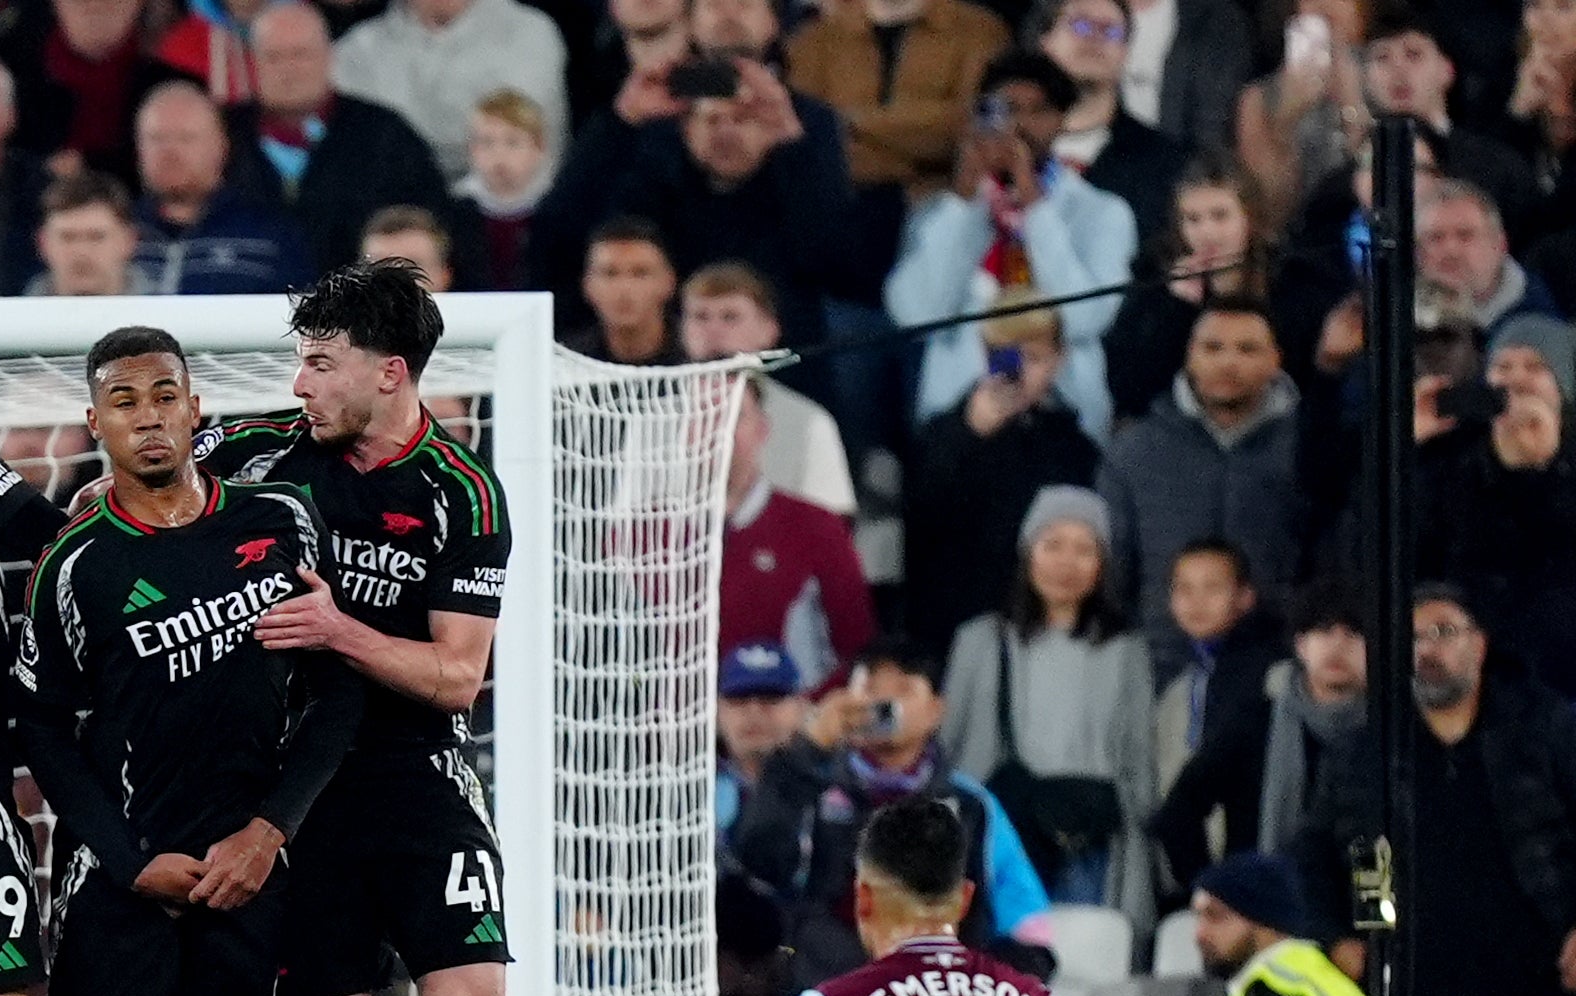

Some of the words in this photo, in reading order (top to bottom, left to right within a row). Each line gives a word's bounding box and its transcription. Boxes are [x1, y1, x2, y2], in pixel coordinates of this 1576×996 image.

[331, 530, 427, 582] irates
[473, 566, 506, 583] VISIT
[337, 569, 402, 607] ETTER
[452, 578, 505, 598] RWAN
[125, 572, 294, 658] Emirates
[168, 642, 202, 683] FLY
[445, 850, 502, 913] 41
